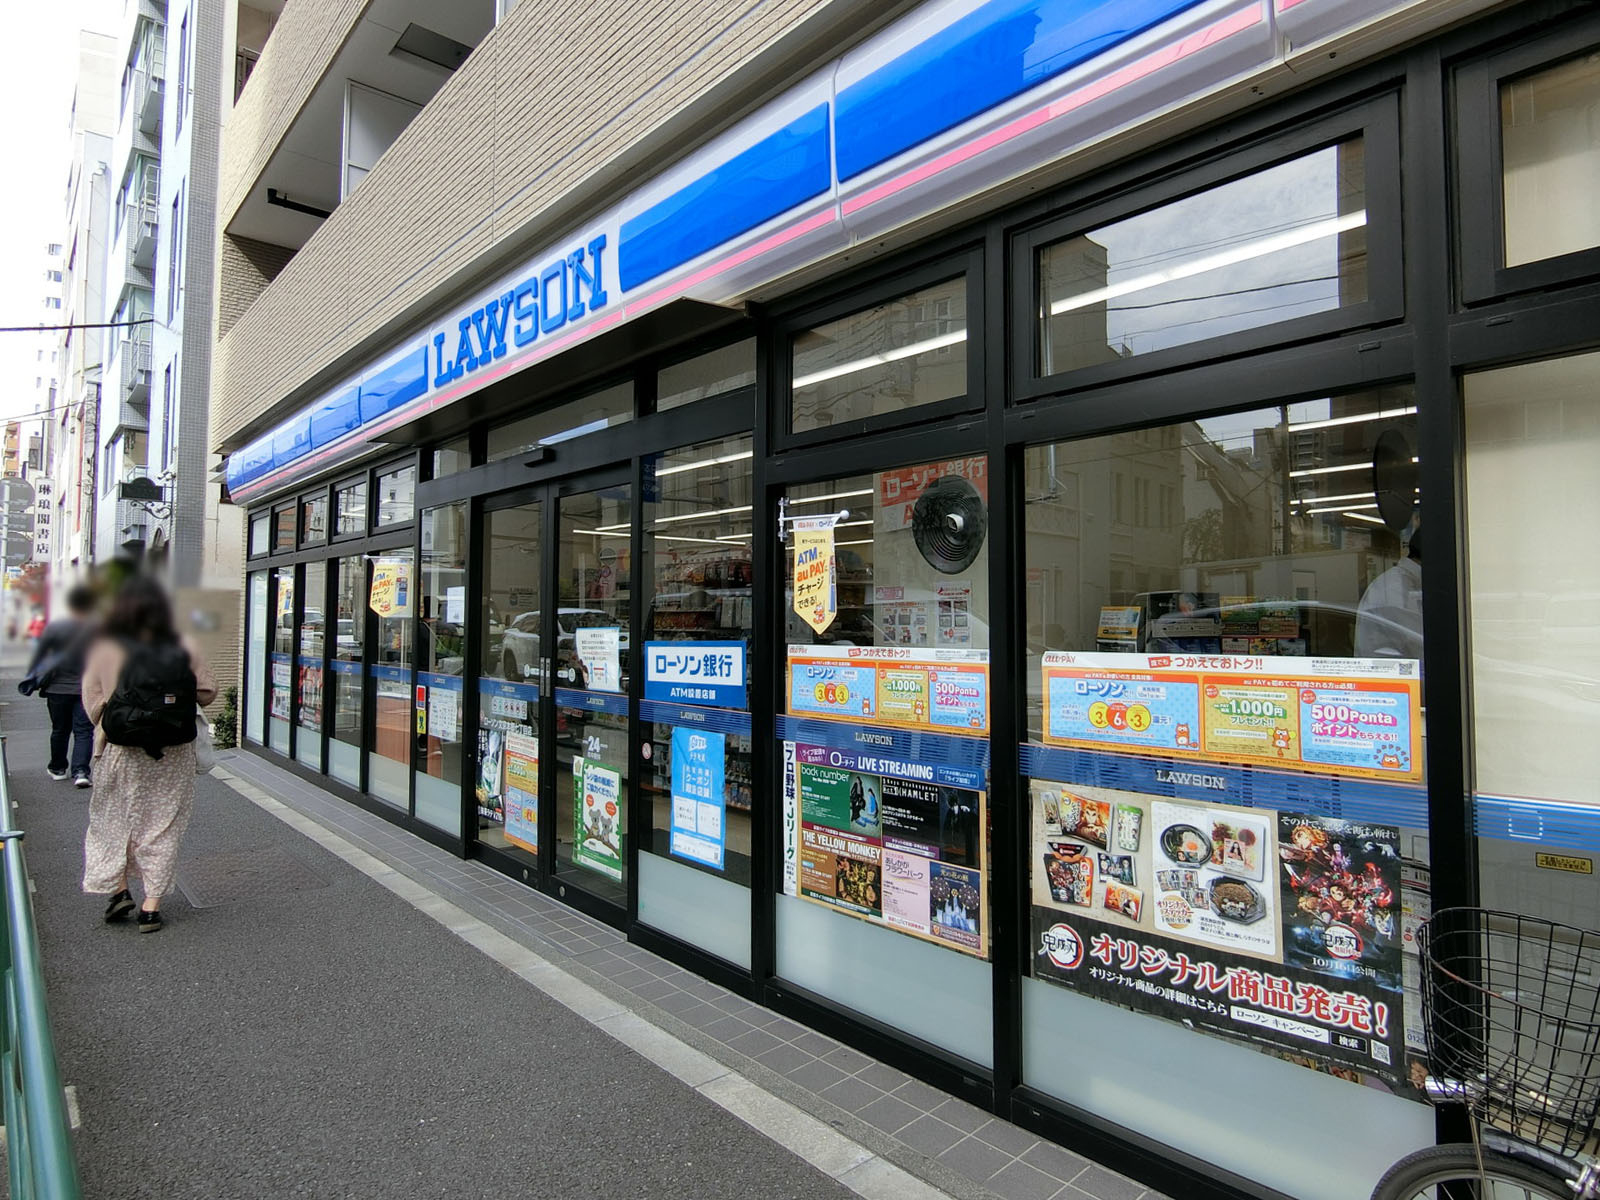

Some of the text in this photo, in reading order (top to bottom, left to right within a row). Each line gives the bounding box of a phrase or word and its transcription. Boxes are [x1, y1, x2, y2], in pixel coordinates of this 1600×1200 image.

[434, 233, 607, 388] LAWSON
[797, 560, 826, 582] au PAY
[797, 575, 824, 596] チャージ
[862, 648, 911, 658] つかえておトク!!
[1045, 654, 1076, 663] au PAY
[655, 654, 733, 678] ローソン銀行
[1175, 656, 1263, 670] つかえておトク!!
[670, 687, 716, 700] ATM設置店舗
[680, 711, 705, 721] LAWSON
[1231, 699, 1285, 717] 1,000円
[1231, 716, 1275, 727] プレゼント!!
[855, 732, 893, 746] LAWSON
[801, 766, 819, 777] back
[820, 770, 850, 782] number
[858, 755, 877, 771] LIVE
[878, 759, 934, 780] STREAMING
[1156, 769, 1225, 790] LAWSON
[803, 830, 816, 843] THE
[817, 833, 846, 851] YELLOW
[848, 841, 881, 860] MONKEY
[885, 864, 924, 880] フラワーパーク
[1090, 933, 1388, 1037] オリジナル商品発売!
[1089, 966, 1227, 1016] オリジナル商品の詳細はこちら
[1236, 1010, 1269, 1024] ローソン
[1272, 1019, 1323, 1038] キャンペーン
[1338, 1034, 1359, 1049] 検索
